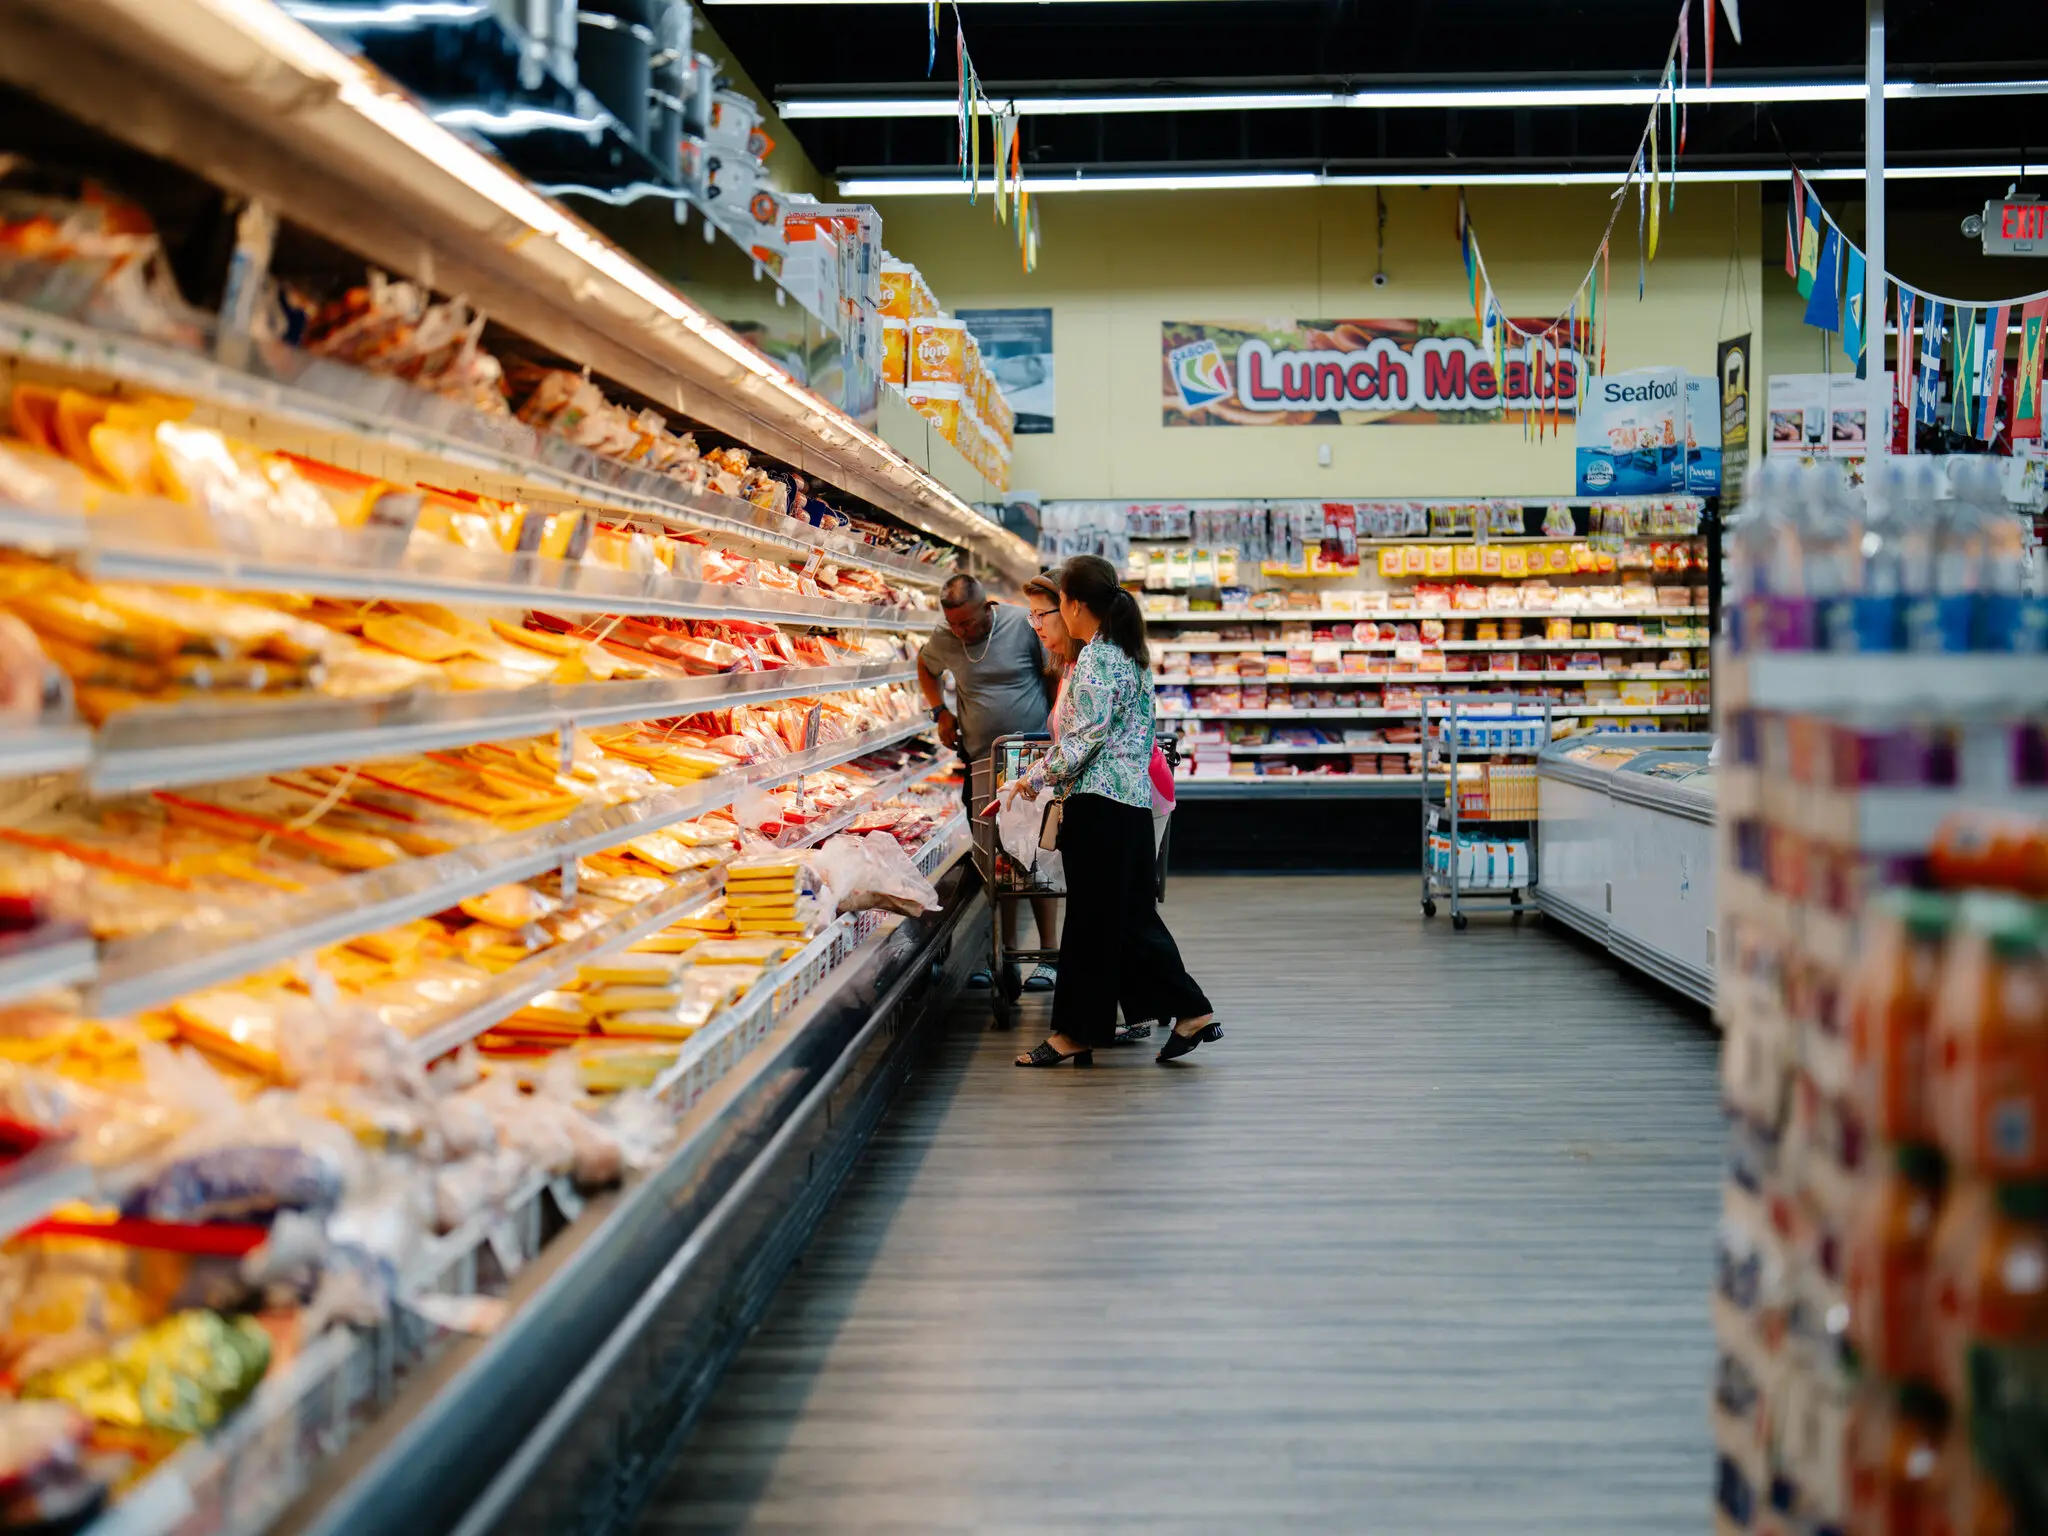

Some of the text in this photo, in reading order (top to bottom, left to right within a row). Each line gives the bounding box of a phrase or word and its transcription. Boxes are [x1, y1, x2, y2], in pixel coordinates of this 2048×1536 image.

[2001, 204, 2048, 240] EXIT
[1249, 350, 1579, 400] Lunch Meats
[1604, 379, 1678, 403] Seafood
